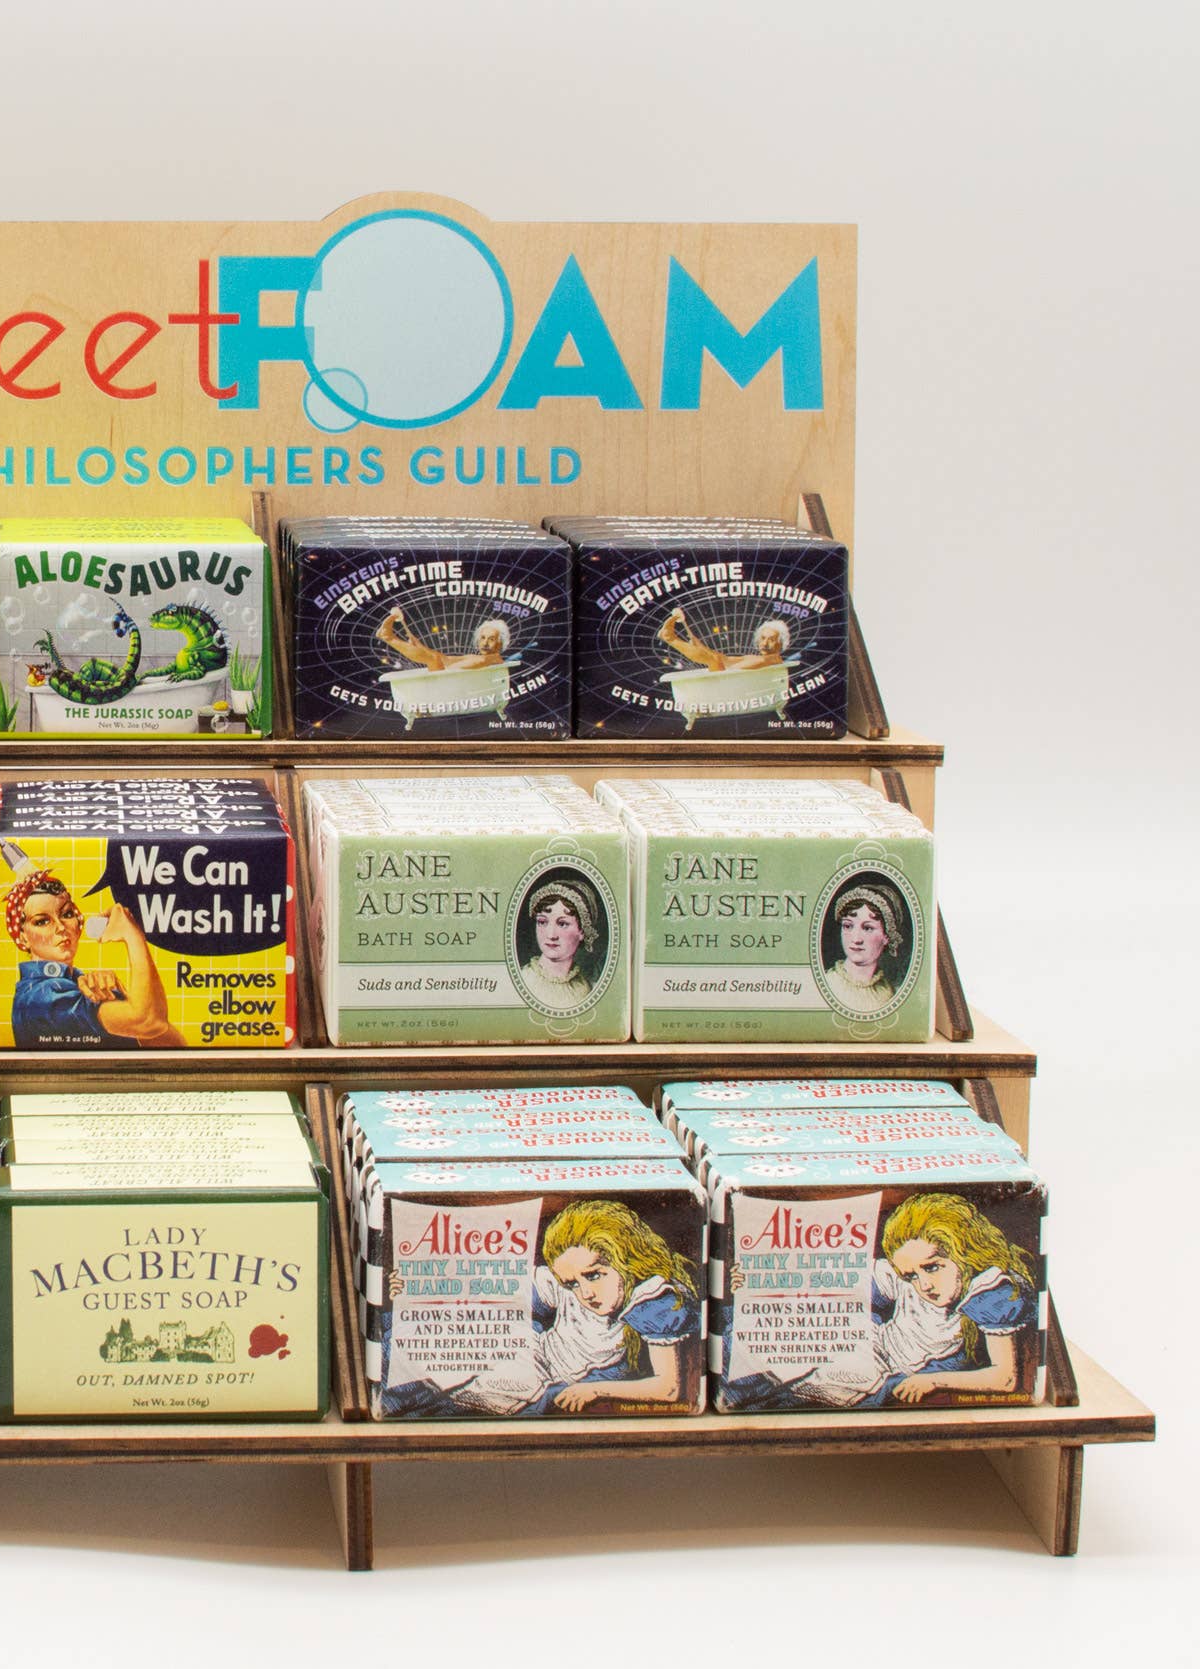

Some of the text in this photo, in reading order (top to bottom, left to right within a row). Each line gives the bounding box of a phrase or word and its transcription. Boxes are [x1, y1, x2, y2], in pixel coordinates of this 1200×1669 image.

[218, 208, 825, 430] FOAM
[410, 445, 584, 488] GUILD
[14, 550, 252, 596] ALOESAURUS
[337, 561, 463, 615] BATH-TIME
[436, 581, 549, 613] CONTINUUM
[619, 562, 743, 616] BATH-TIME
[716, 582, 828, 613] CONTINUUM
[492, 601, 530, 618] SOAP
[773, 602, 809, 619] SOAP
[330, 675, 547, 713] GETS YOU RELATIVELY CLEAN
[611, 675, 826, 713] GETS YOU RELATIVELY CLEAN
[65, 708, 193, 719] THE JURASSIC SOAP
[121, 845, 249, 885] We Can
[357, 856, 451, 880] JANE
[665, 858, 759, 880] JANE
[138, 894, 282, 933] Wash It!
[356, 892, 501, 915] AUSTEN
[663, 895, 807, 917] AUSTEN
[357, 933, 477, 946] BATH SOAP
[664, 935, 782, 947] BATH SOAP
[177, 962, 276, 988] Removes
[358, 978, 498, 993] Suds and Sensibility
[663, 980, 802, 995] Suds and Sensibility
[208, 990, 276, 1015] elbow
[201, 1021, 280, 1043] grease.
[124, 1227, 208, 1247] LADY
[398, 1212, 528, 1256] Alice's
[740, 1206, 868, 1250] Alice's
[399, 1259, 528, 1276] TINY LITTLE
[740, 1253, 867, 1270] TINY LITTLE
[30, 1251, 301, 1298] MACBETH'S
[748, 1272, 859, 1288] HAND SOAP
[406, 1279, 519, 1296] HAND SOAP
[83, 1291, 248, 1310] GUEST SOAP
[741, 1302, 865, 1315] GROWS SMALLER
[400, 1309, 525, 1323] GROWS SMALLER
[755, 1317, 850, 1328] AND SMALLER
[414, 1324, 511, 1335] AND SMALLER
[737, 1331, 869, 1342] WITH REPEATED USE,
[396, 1338, 530, 1349] WITH REPEATED USE,
[748, 1344, 856, 1353] THEN SHRINKS AWAY
[407, 1352, 517, 1360] THEN SHRINKS AWAY
[76, 1373, 255, 1387] OUT, DAMNED SPOT!
